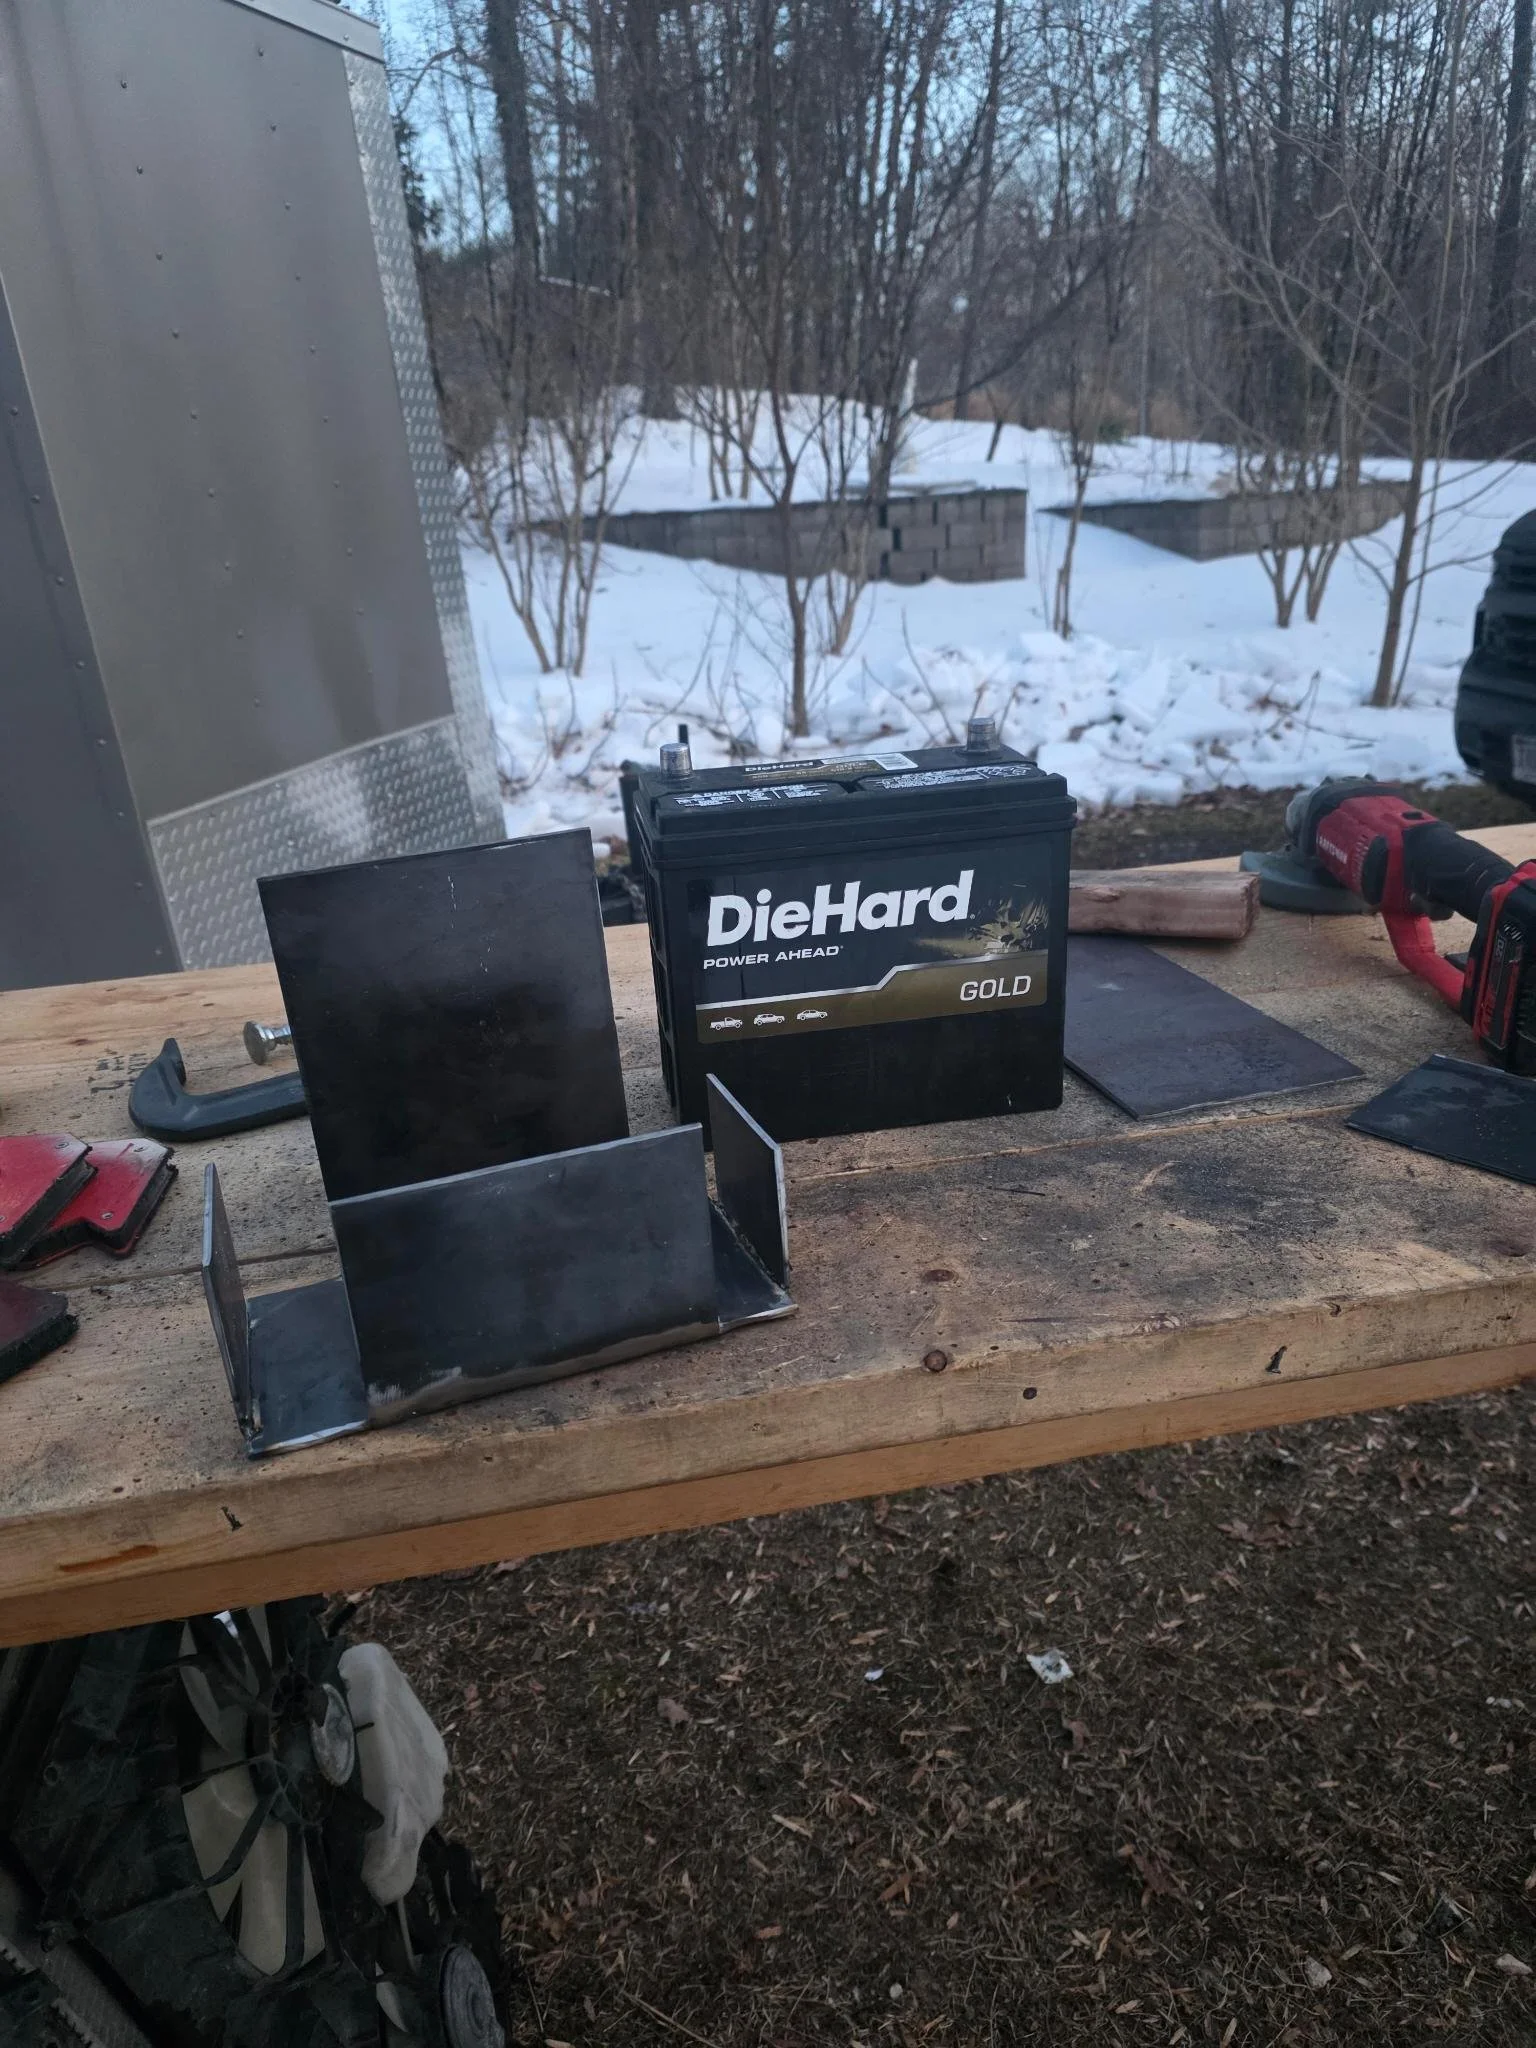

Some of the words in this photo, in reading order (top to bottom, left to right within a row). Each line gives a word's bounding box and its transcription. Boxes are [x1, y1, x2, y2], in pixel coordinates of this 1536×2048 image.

[707, 869, 974, 946] DieHard
[703, 952, 770, 970] POWER
[775, 946, 840, 961] AHEAD
[959, 976, 1032, 1001] GOLD
